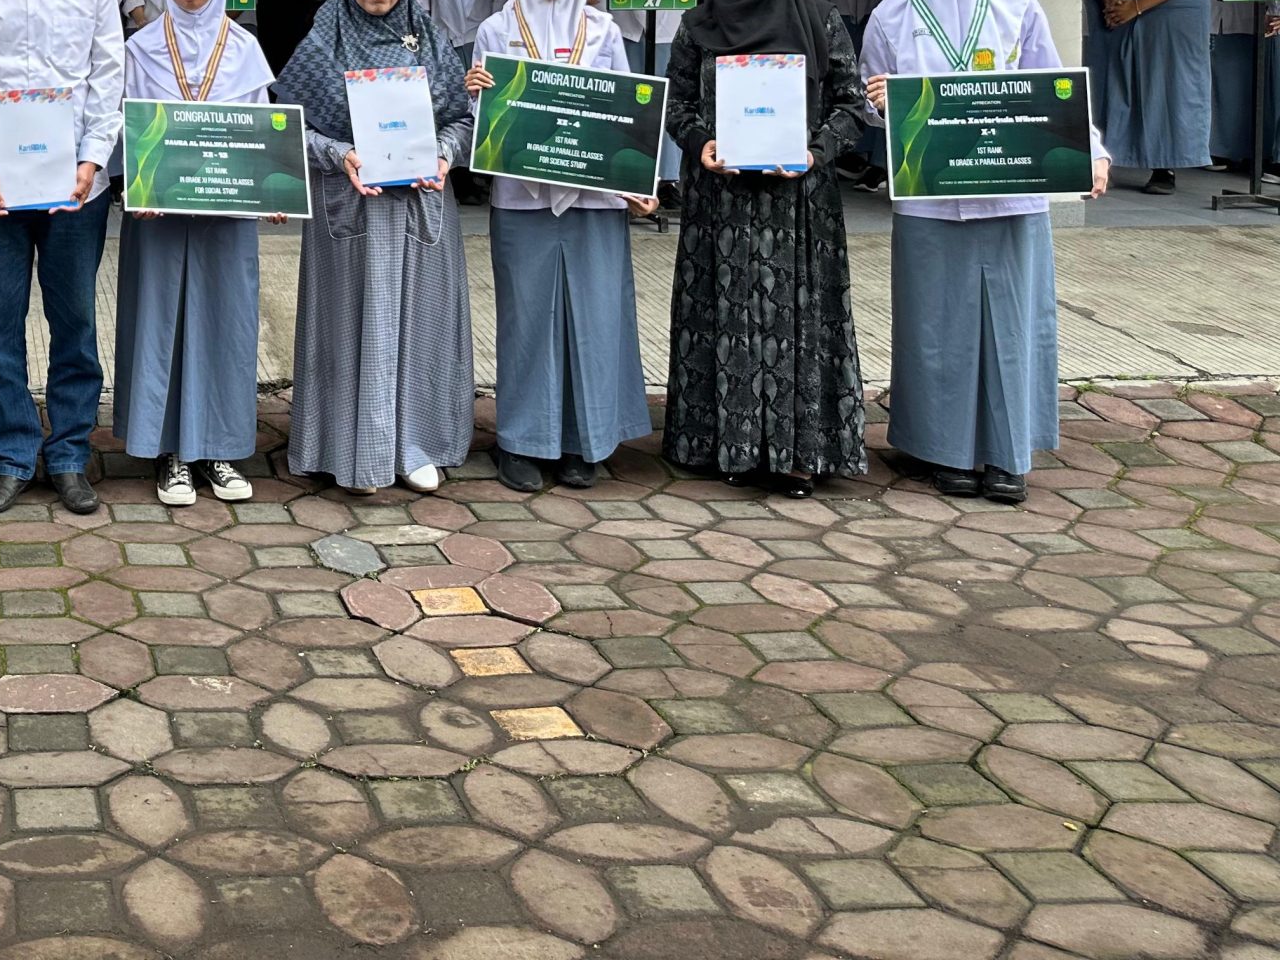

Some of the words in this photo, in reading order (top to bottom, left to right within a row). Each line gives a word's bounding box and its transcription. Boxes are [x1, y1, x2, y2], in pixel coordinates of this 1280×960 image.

[531, 70, 616, 94] CONGRATULATION
[940, 80, 1031, 97] CONGRATULATION
[173, 111, 254, 125] CONGRATULATION
[555, 136, 564, 144] 1ST
[564, 137, 578, 146] RANK
[533, 144, 550, 152] GRADE
[555, 147, 580, 157] PARALLEL
[581, 151, 604, 161] CLASSES
[539, 156, 550, 164] FOR
[549, 157, 570, 167] SCIENCE
[570, 160, 587, 170] STUDY
